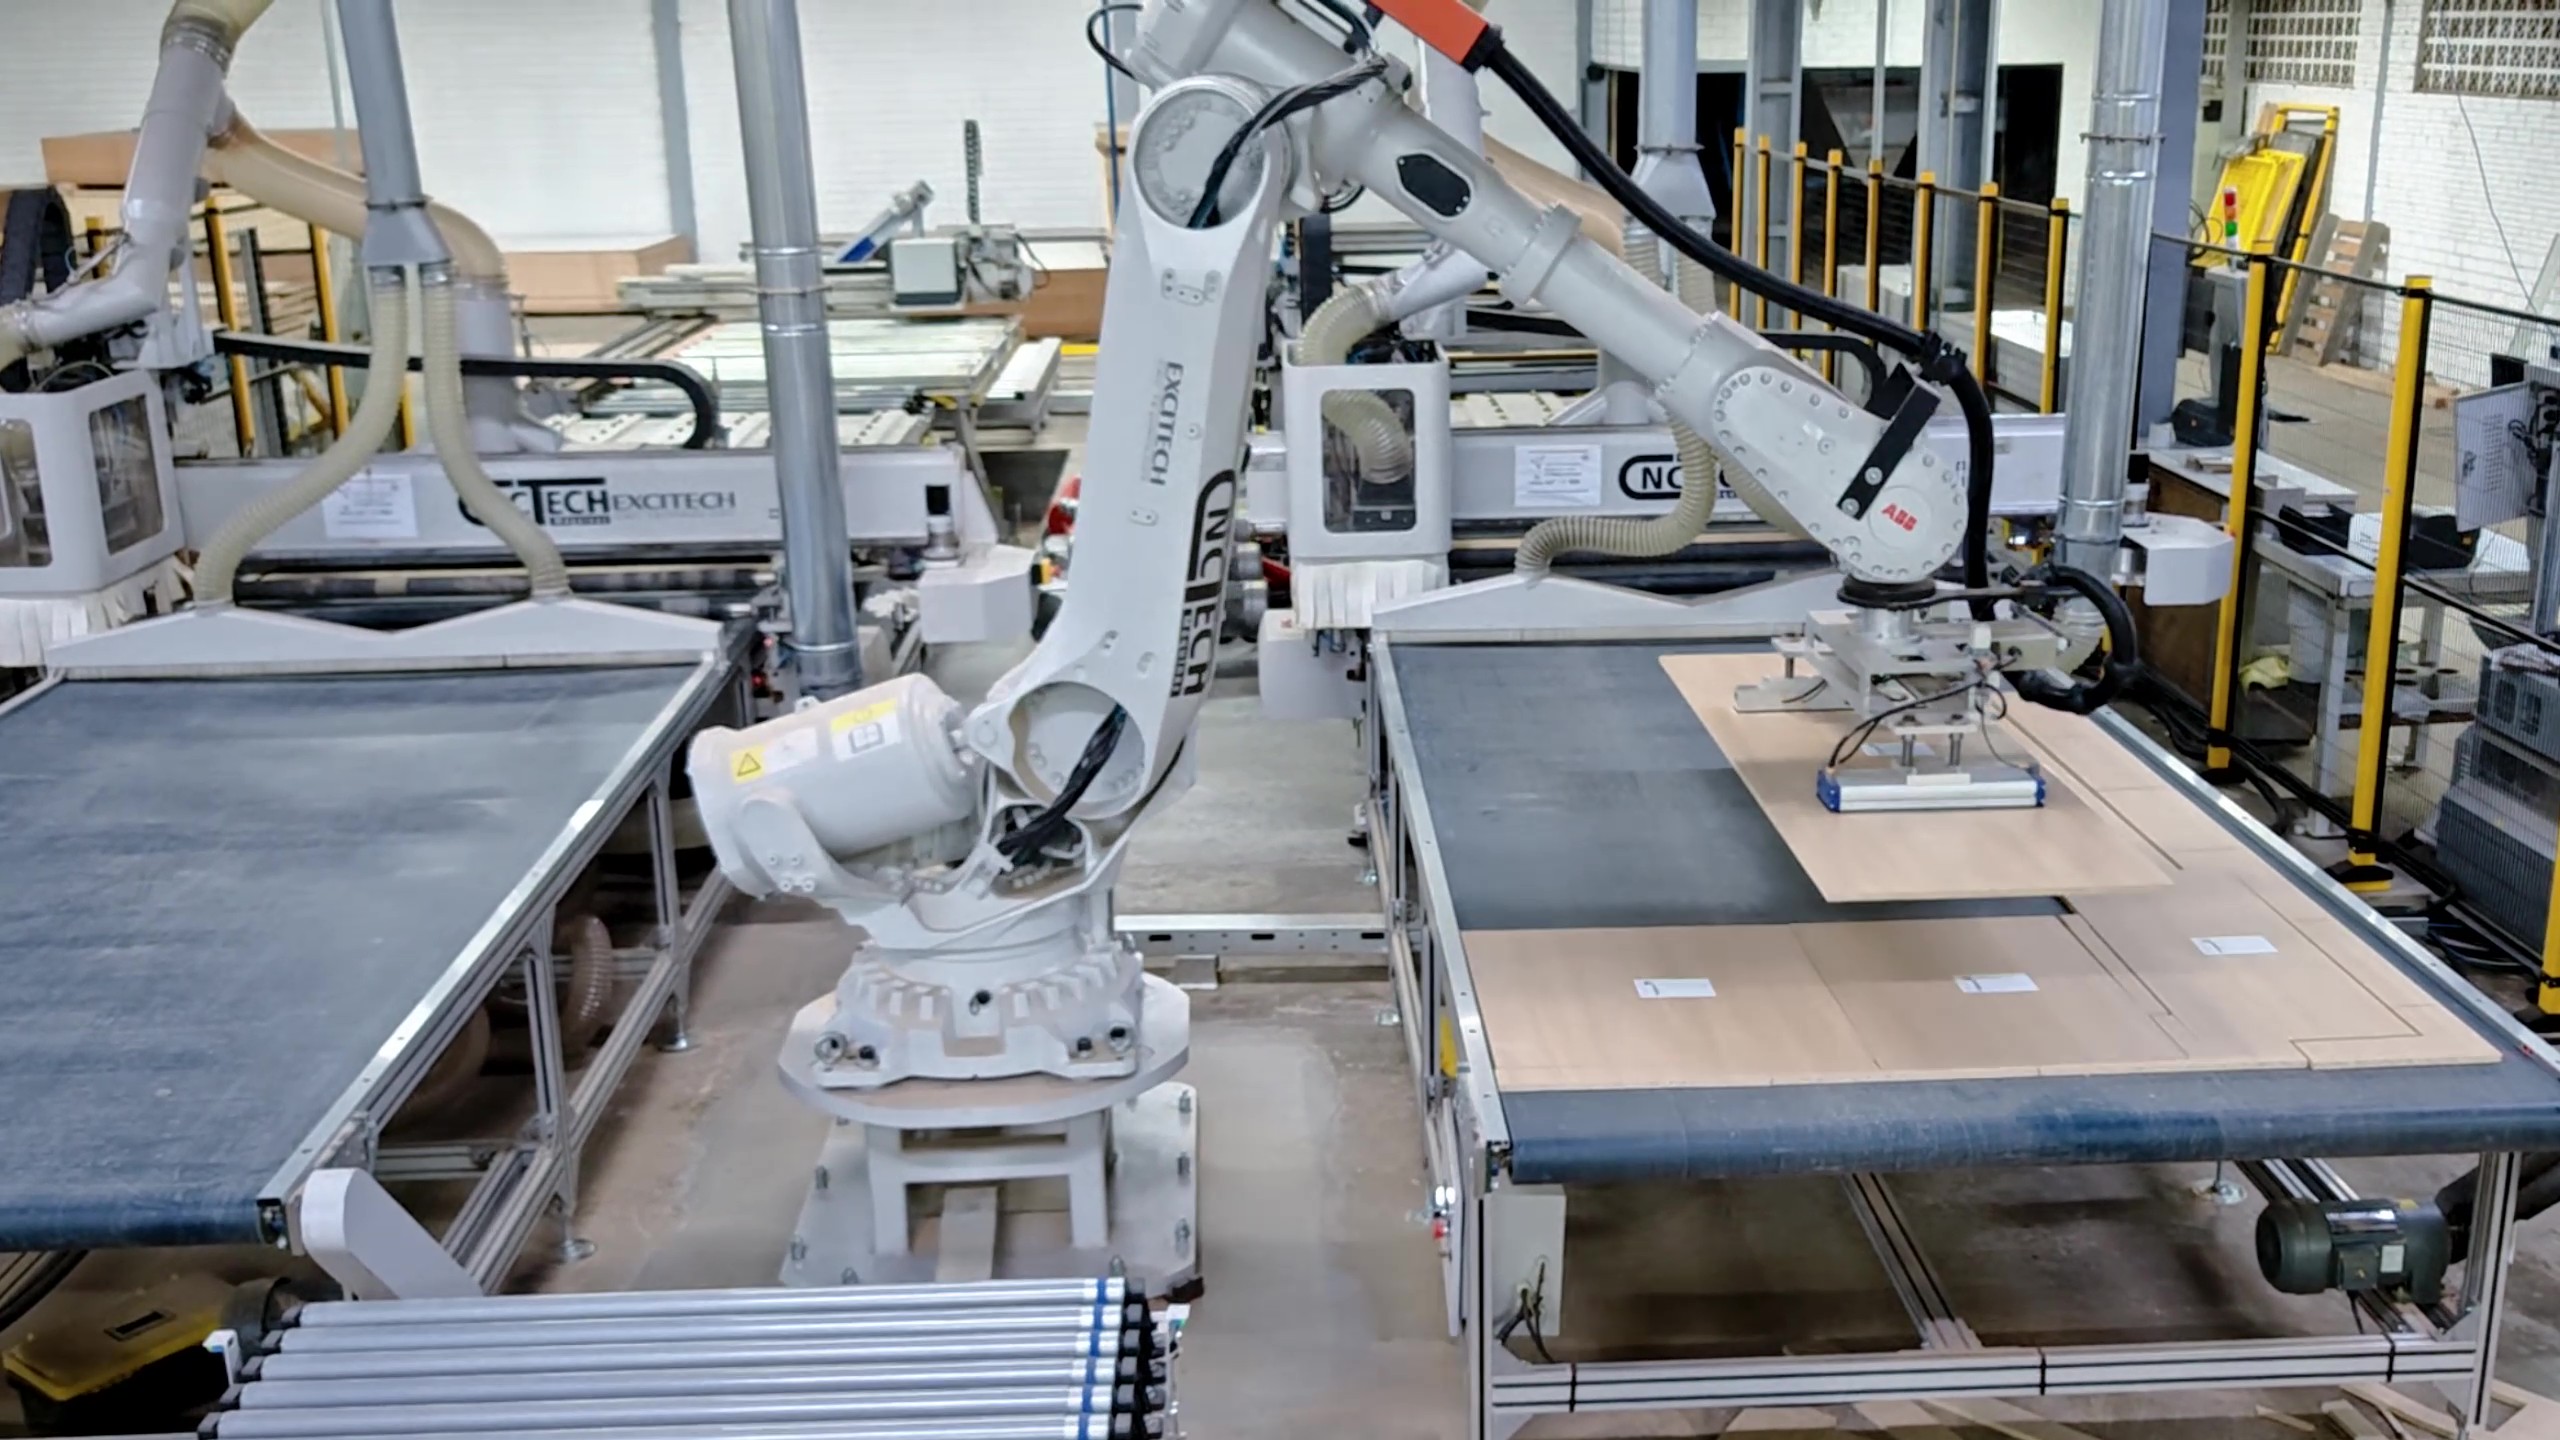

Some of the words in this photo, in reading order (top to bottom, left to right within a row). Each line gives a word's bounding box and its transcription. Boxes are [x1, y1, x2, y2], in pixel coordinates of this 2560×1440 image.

[1149, 361, 1184, 486] EXCITECH
[611, 490, 737, 511] EXCITECH
[1881, 502, 1918, 532] ABB
